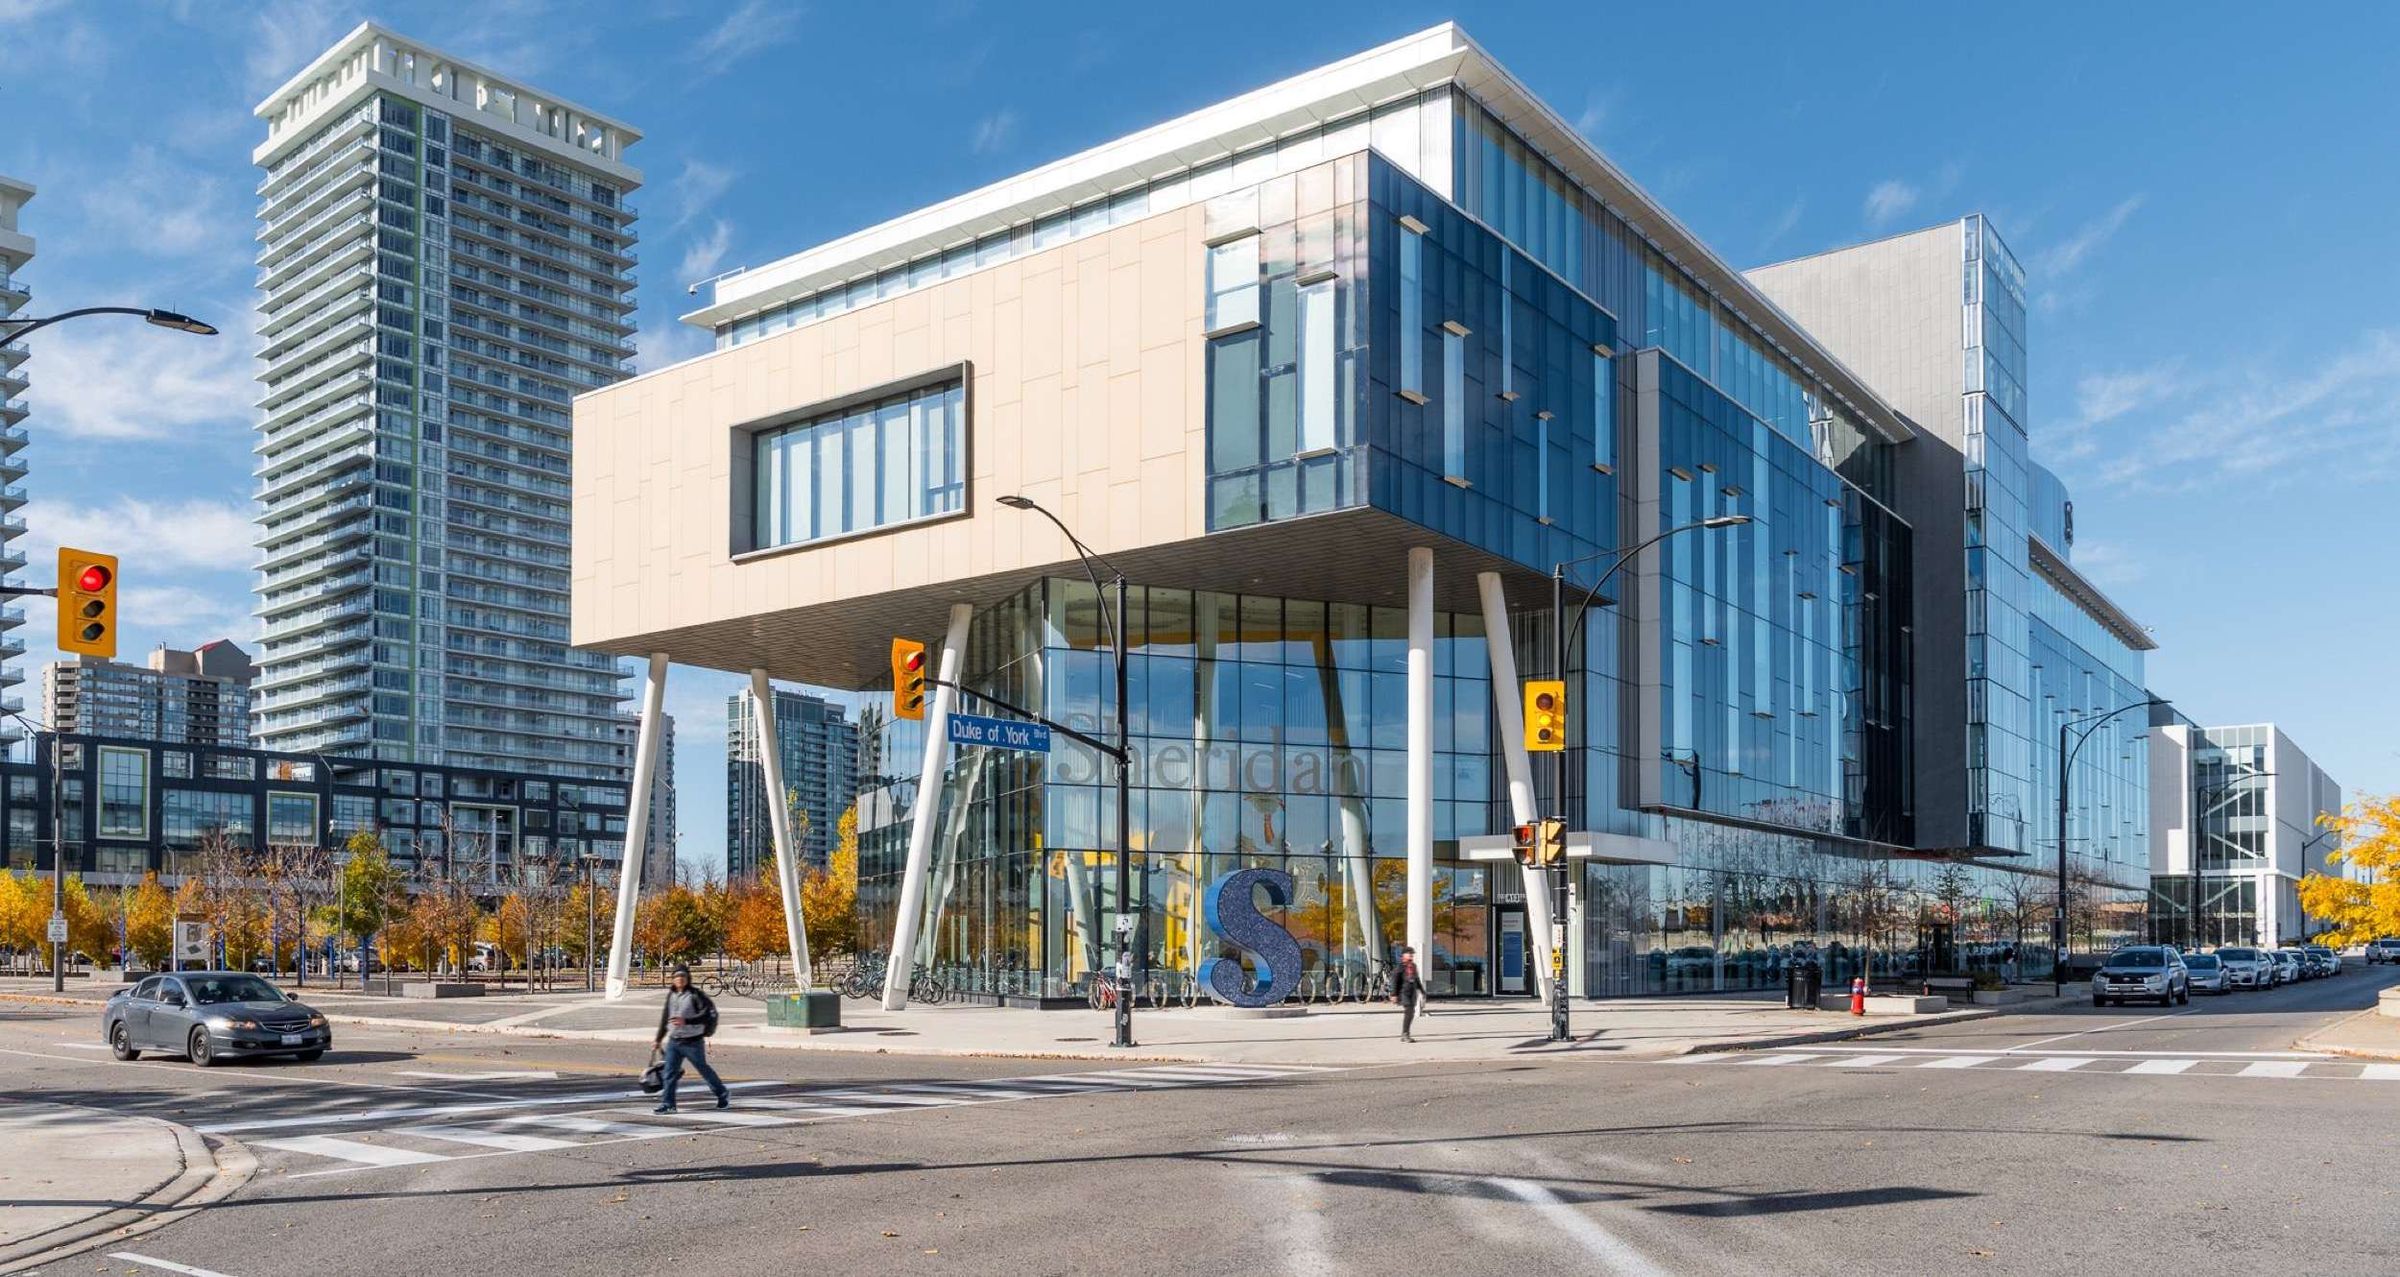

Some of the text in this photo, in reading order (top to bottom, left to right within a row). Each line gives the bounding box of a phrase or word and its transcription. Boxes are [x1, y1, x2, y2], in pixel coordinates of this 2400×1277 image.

[953, 720, 981, 740] Duke
[988, 725, 999, 742] of
[1006, 726, 1029, 746] York
[1057, 712, 1365, 797] Sheridan
[1197, 868, 1303, 1008] S
